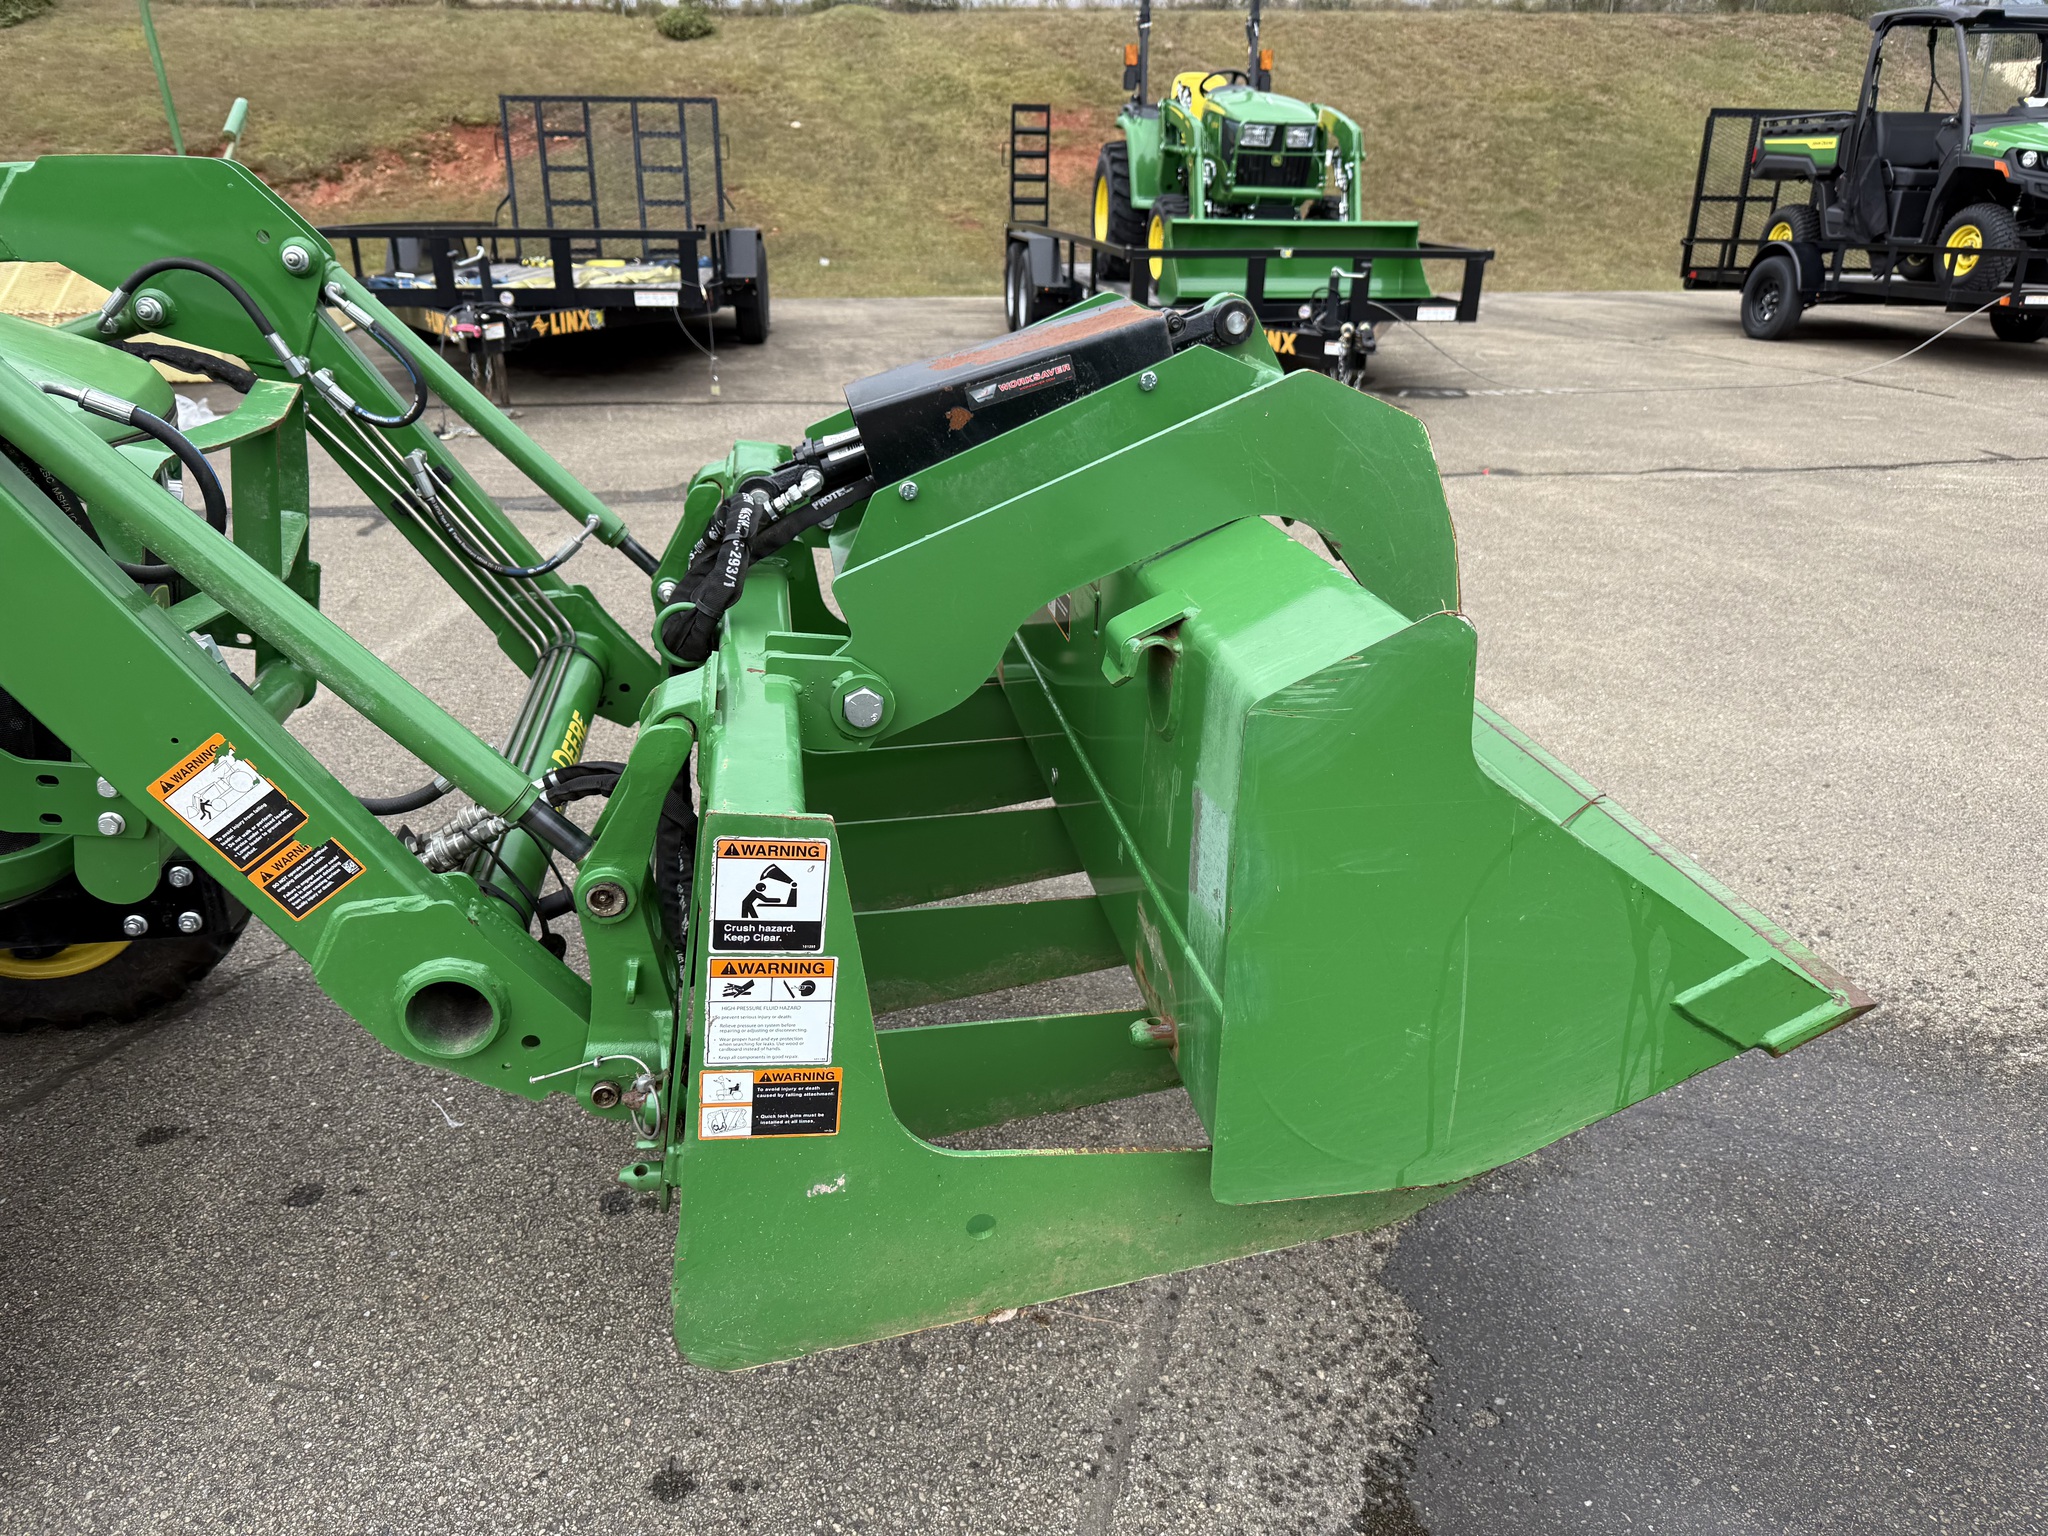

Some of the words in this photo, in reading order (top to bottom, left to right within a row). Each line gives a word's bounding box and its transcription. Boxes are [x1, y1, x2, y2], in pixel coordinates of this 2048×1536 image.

[550, 308, 592, 335] LINX
[1264, 329, 1297, 354] NX
[998, 364, 1070, 392] WORKSAVER
[52, 487, 71, 512] MSHA
[552, 710, 588, 768] DEERE
[170, 744, 218, 783] WARNING
[740, 844, 820, 858] WARNING
[724, 924, 756, 932] Crush
[758, 924, 796, 932] hazard.
[724, 934, 750, 942] Keep
[738, 962, 825, 974] WARNING
[772, 1072, 835, 1081] WARNING
